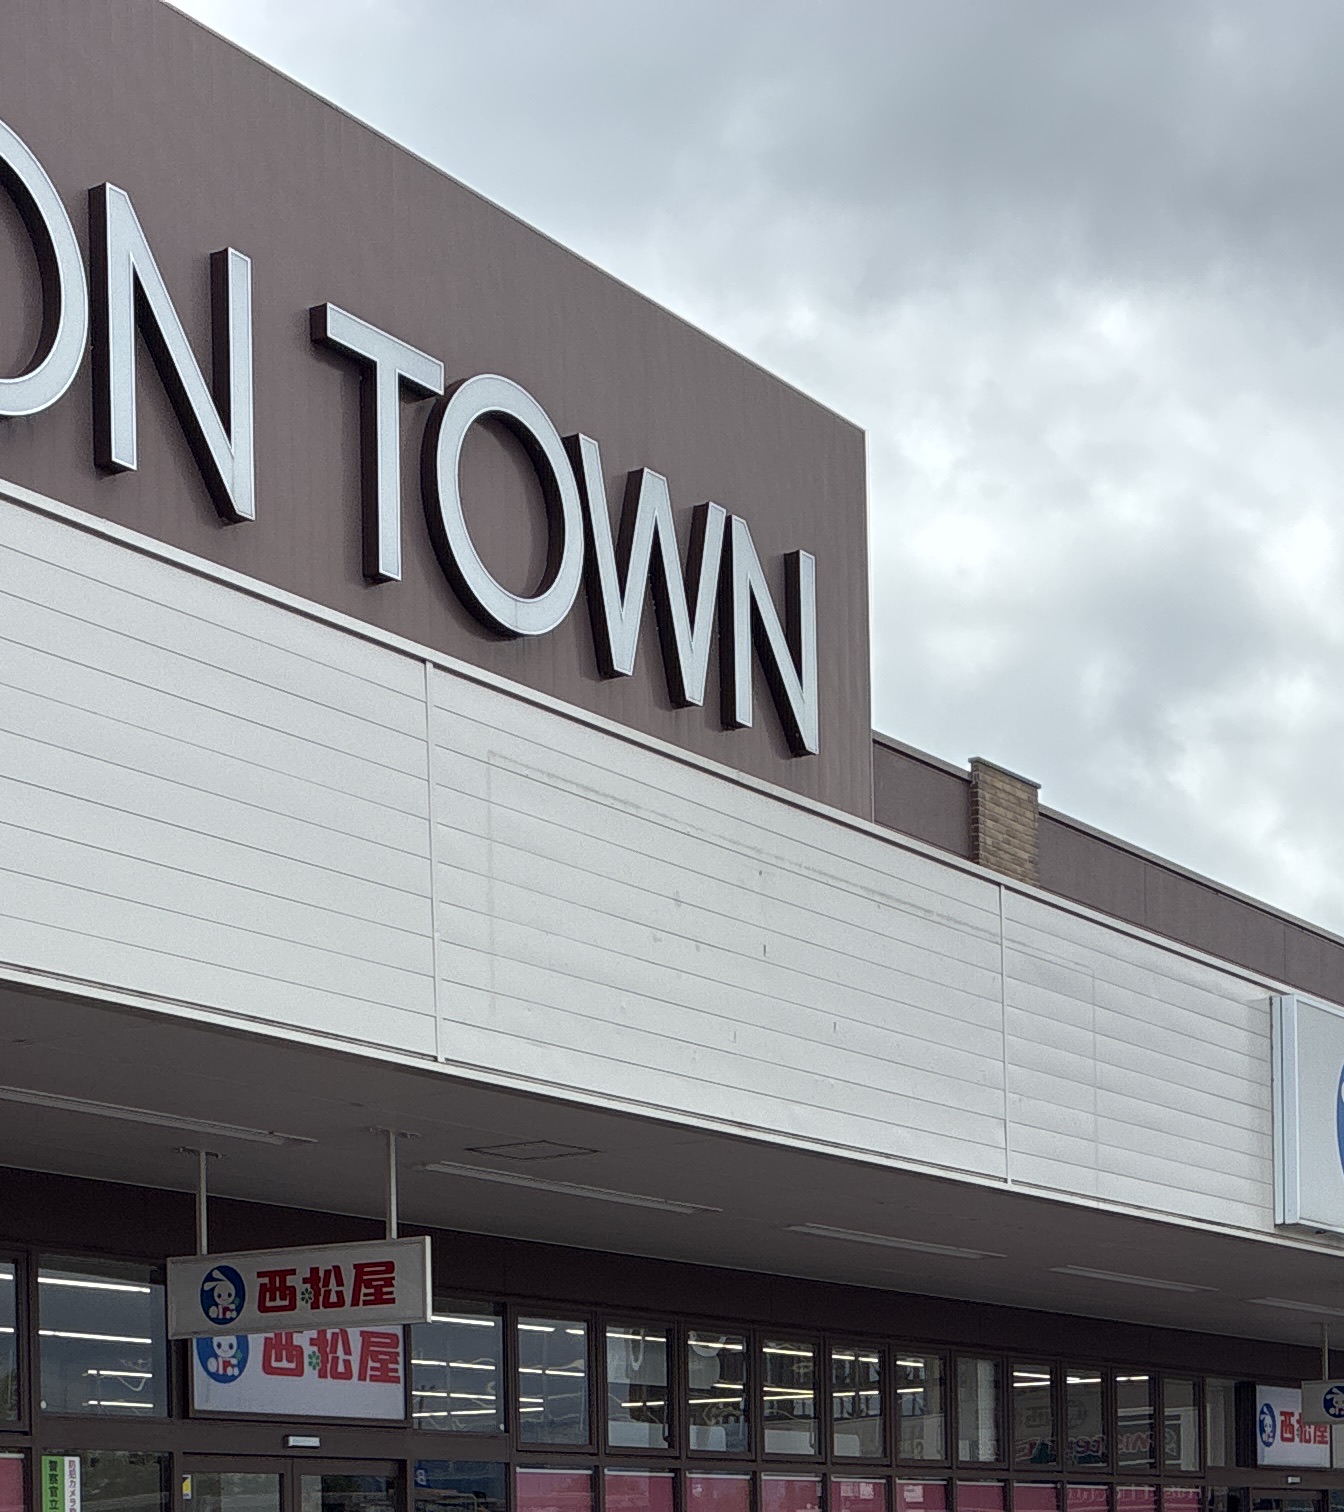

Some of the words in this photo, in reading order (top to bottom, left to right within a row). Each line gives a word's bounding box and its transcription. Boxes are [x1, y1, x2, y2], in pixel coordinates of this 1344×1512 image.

[312, 303, 817, 757] TOWN
[256, 1260, 397, 1314] 西松屋
[262, 1328, 402, 1386] 西松屋
